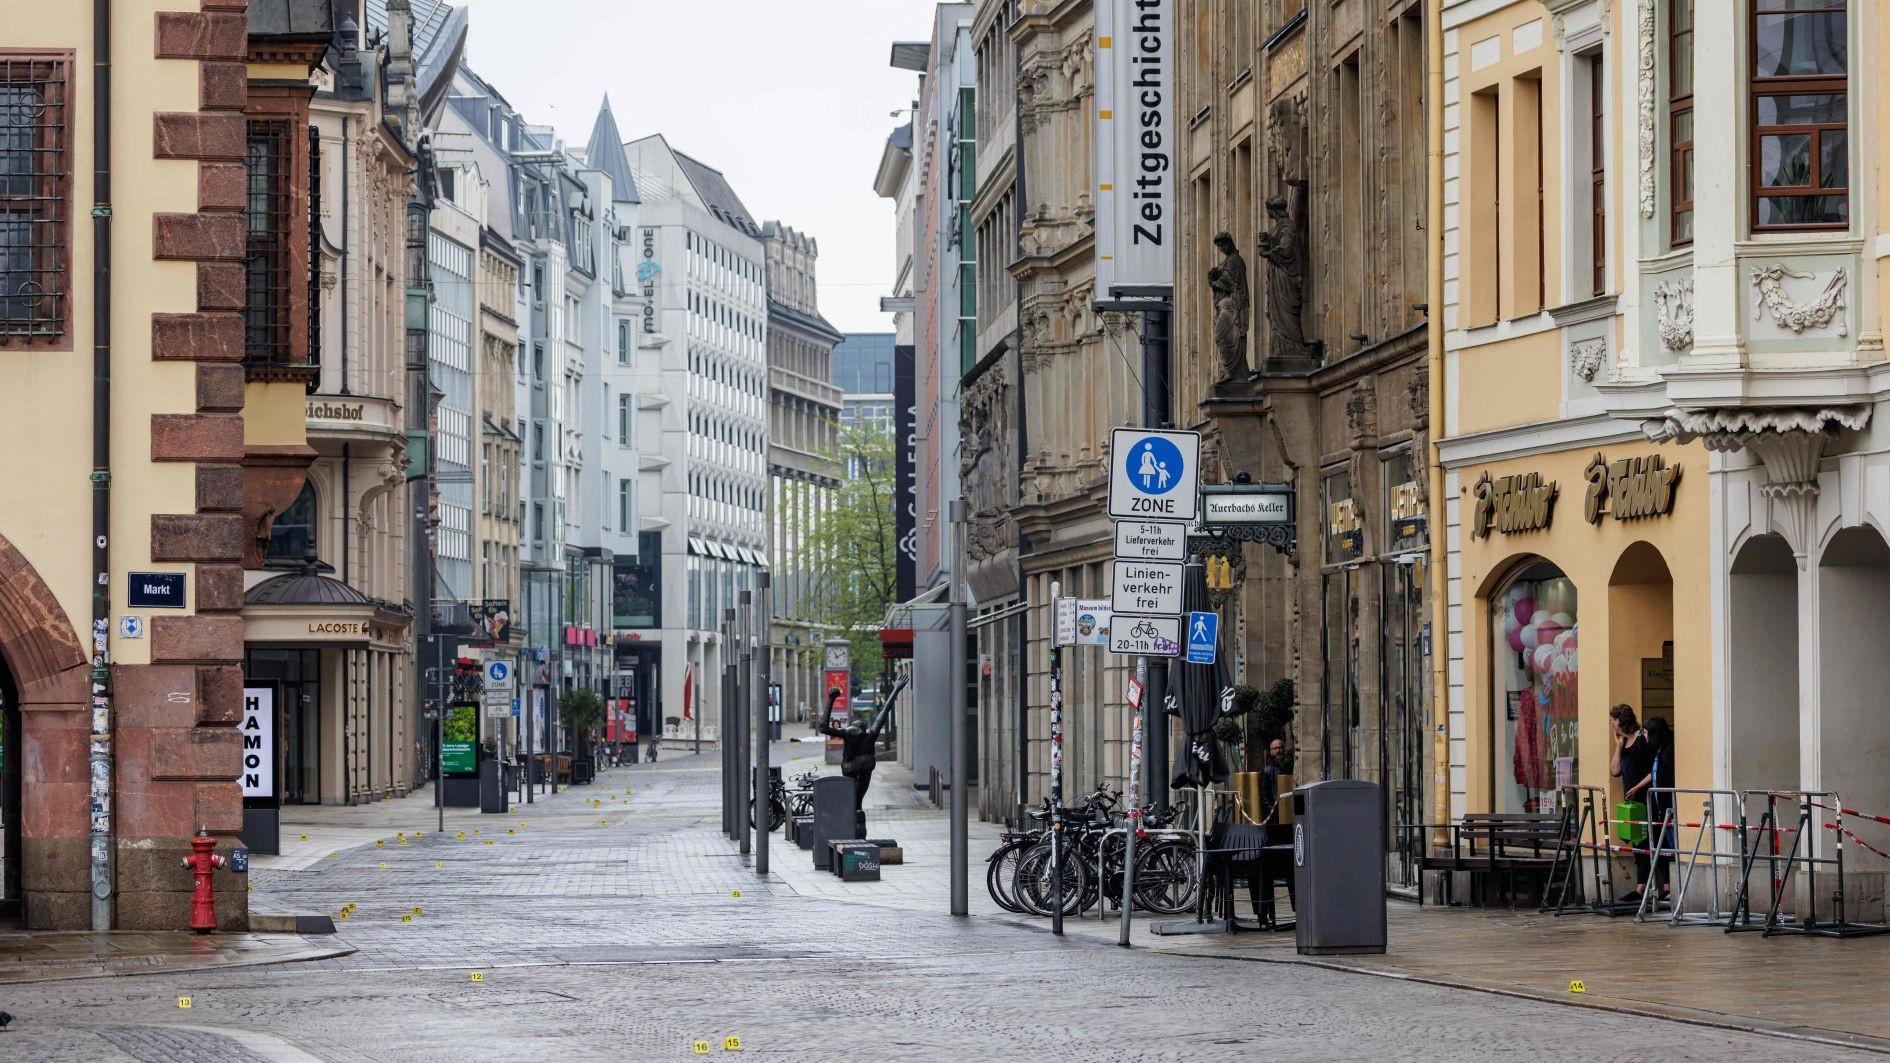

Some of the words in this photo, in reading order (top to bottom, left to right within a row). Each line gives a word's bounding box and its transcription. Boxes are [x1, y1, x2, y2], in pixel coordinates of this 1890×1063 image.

[305, 402, 364, 421] ichshof
[1131, 497, 1175, 513] ZONE
[1209, 503, 1256, 514] Auerbachs
[1257, 503, 1284, 512] Keller
[1140, 525, 1162, 535] 5-11h
[1126, 535, 1175, 546] Lieferverkehr
[1142, 547, 1159, 556] frei
[1126, 567, 1171, 579] Linien-
[143, 584, 170, 595] Markt
[1123, 582, 1173, 595] verkehr
[1137, 597, 1158, 609] frei
[308, 623, 358, 634] LACOSTE
[1117, 640, 1149, 650] 20-11h
[695, 1043, 708, 1051] 16
[727, 1038, 739, 1047] 15
